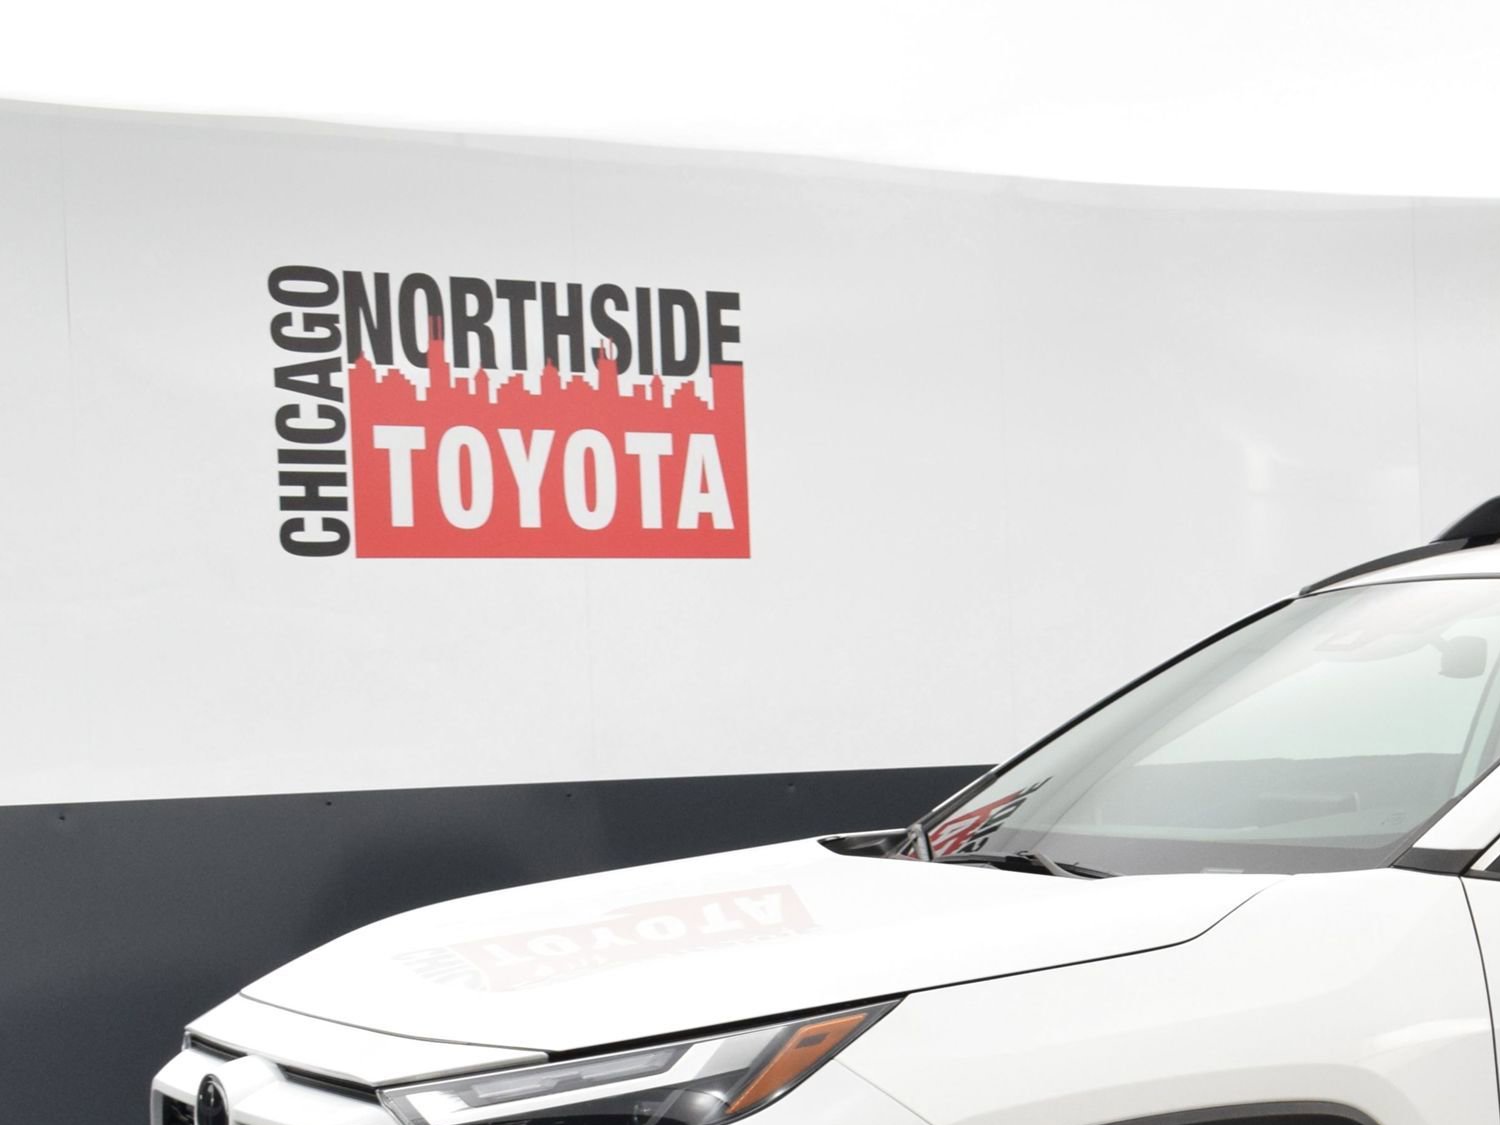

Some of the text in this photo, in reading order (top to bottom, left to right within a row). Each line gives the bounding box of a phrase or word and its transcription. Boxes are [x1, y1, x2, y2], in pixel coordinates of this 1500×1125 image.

[342, 270, 744, 377] NORTHSIDE
[267, 265, 351, 558] CHICAGO
[373, 425, 734, 530] TOYOTA
